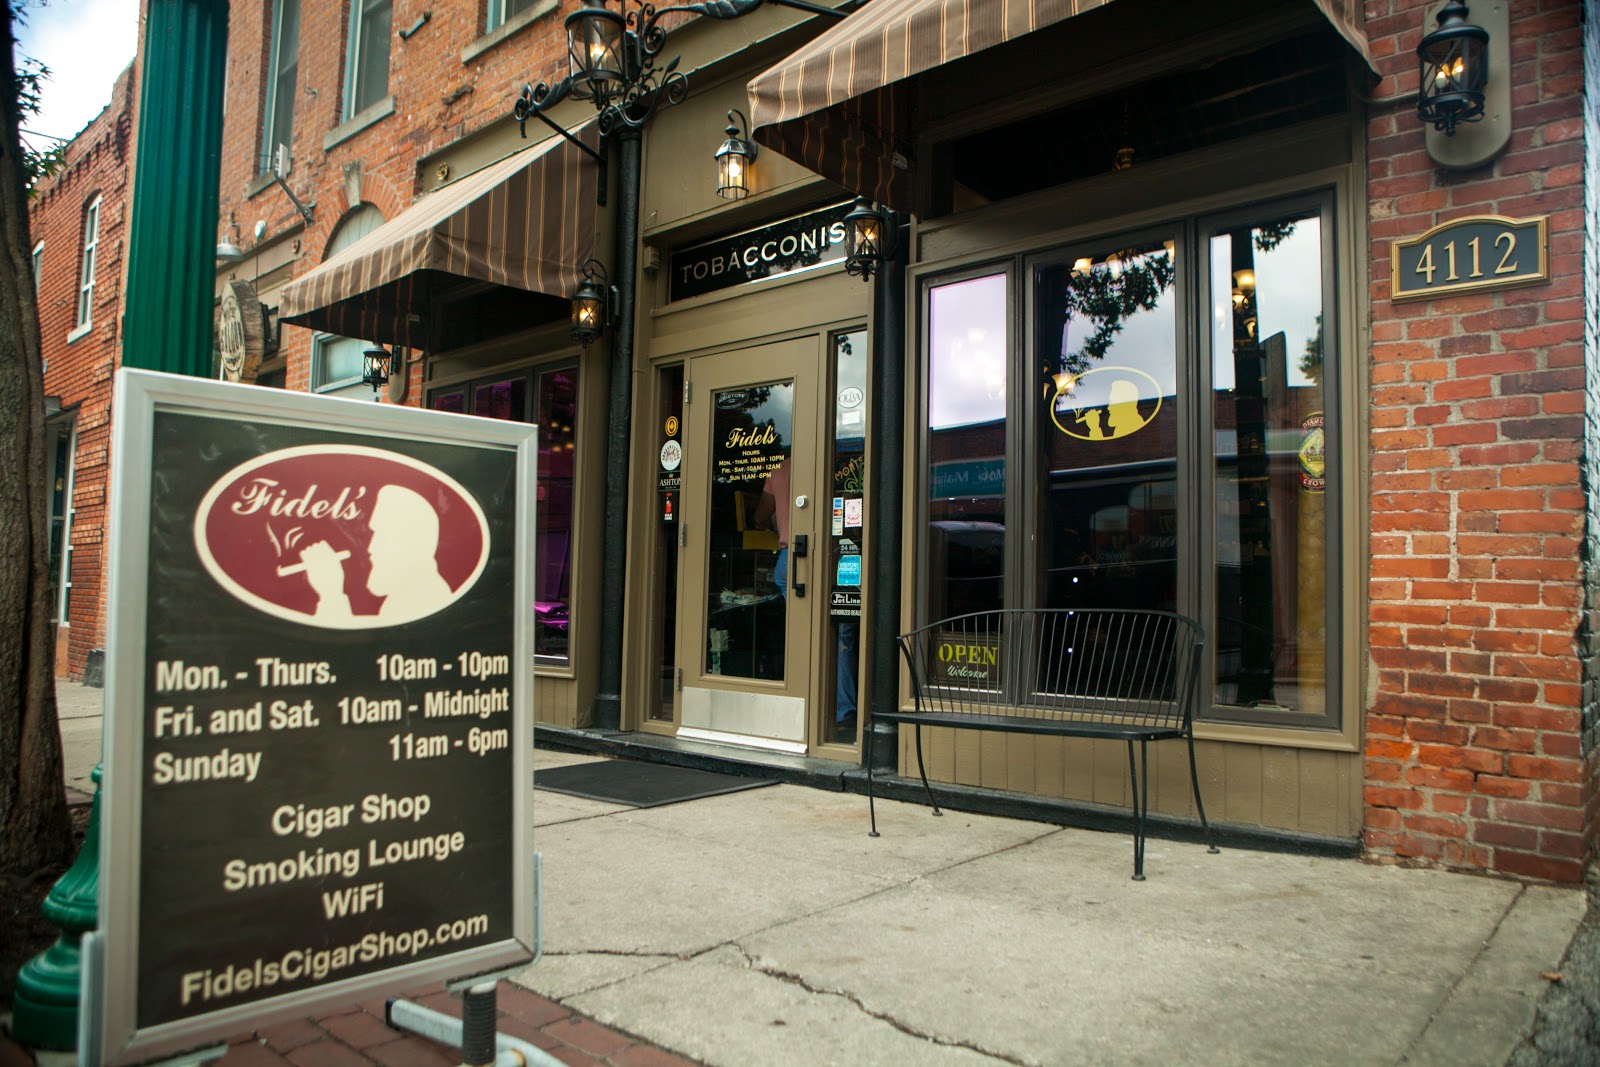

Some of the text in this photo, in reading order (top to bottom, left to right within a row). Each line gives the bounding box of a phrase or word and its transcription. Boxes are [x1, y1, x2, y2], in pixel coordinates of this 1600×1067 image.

[680, 221, 846, 284] TOBACCONIS
[1415, 232, 1518, 284] 4112
[1303, 478, 1325, 487] CROW
[155, 660, 228, 692] Mon.
[255, 657, 337, 687] Thurs.
[376, 653, 437, 681] 10am
[457, 651, 509, 681] 10pm
[938, 643, 998, 666] OPEN
[946, 664, 988, 679] Welcome
[154, 706, 202, 738] Fri.
[209, 702, 262, 734] and
[269, 700, 320, 729] Sat.
[337, 696, 402, 724] 10am
[424, 687, 510, 719] Midnight
[152, 748, 262, 784] Sunday
[389, 733, 448, 761] 11am
[468, 727, 508, 756] 6pm
[271, 793, 431, 838] Cigar Shop
[223, 831, 465, 891] Smoking Lounge
[322, 882, 384, 920] WiFi
[181, 914, 489, 1006] FidelsCigarShop.com
